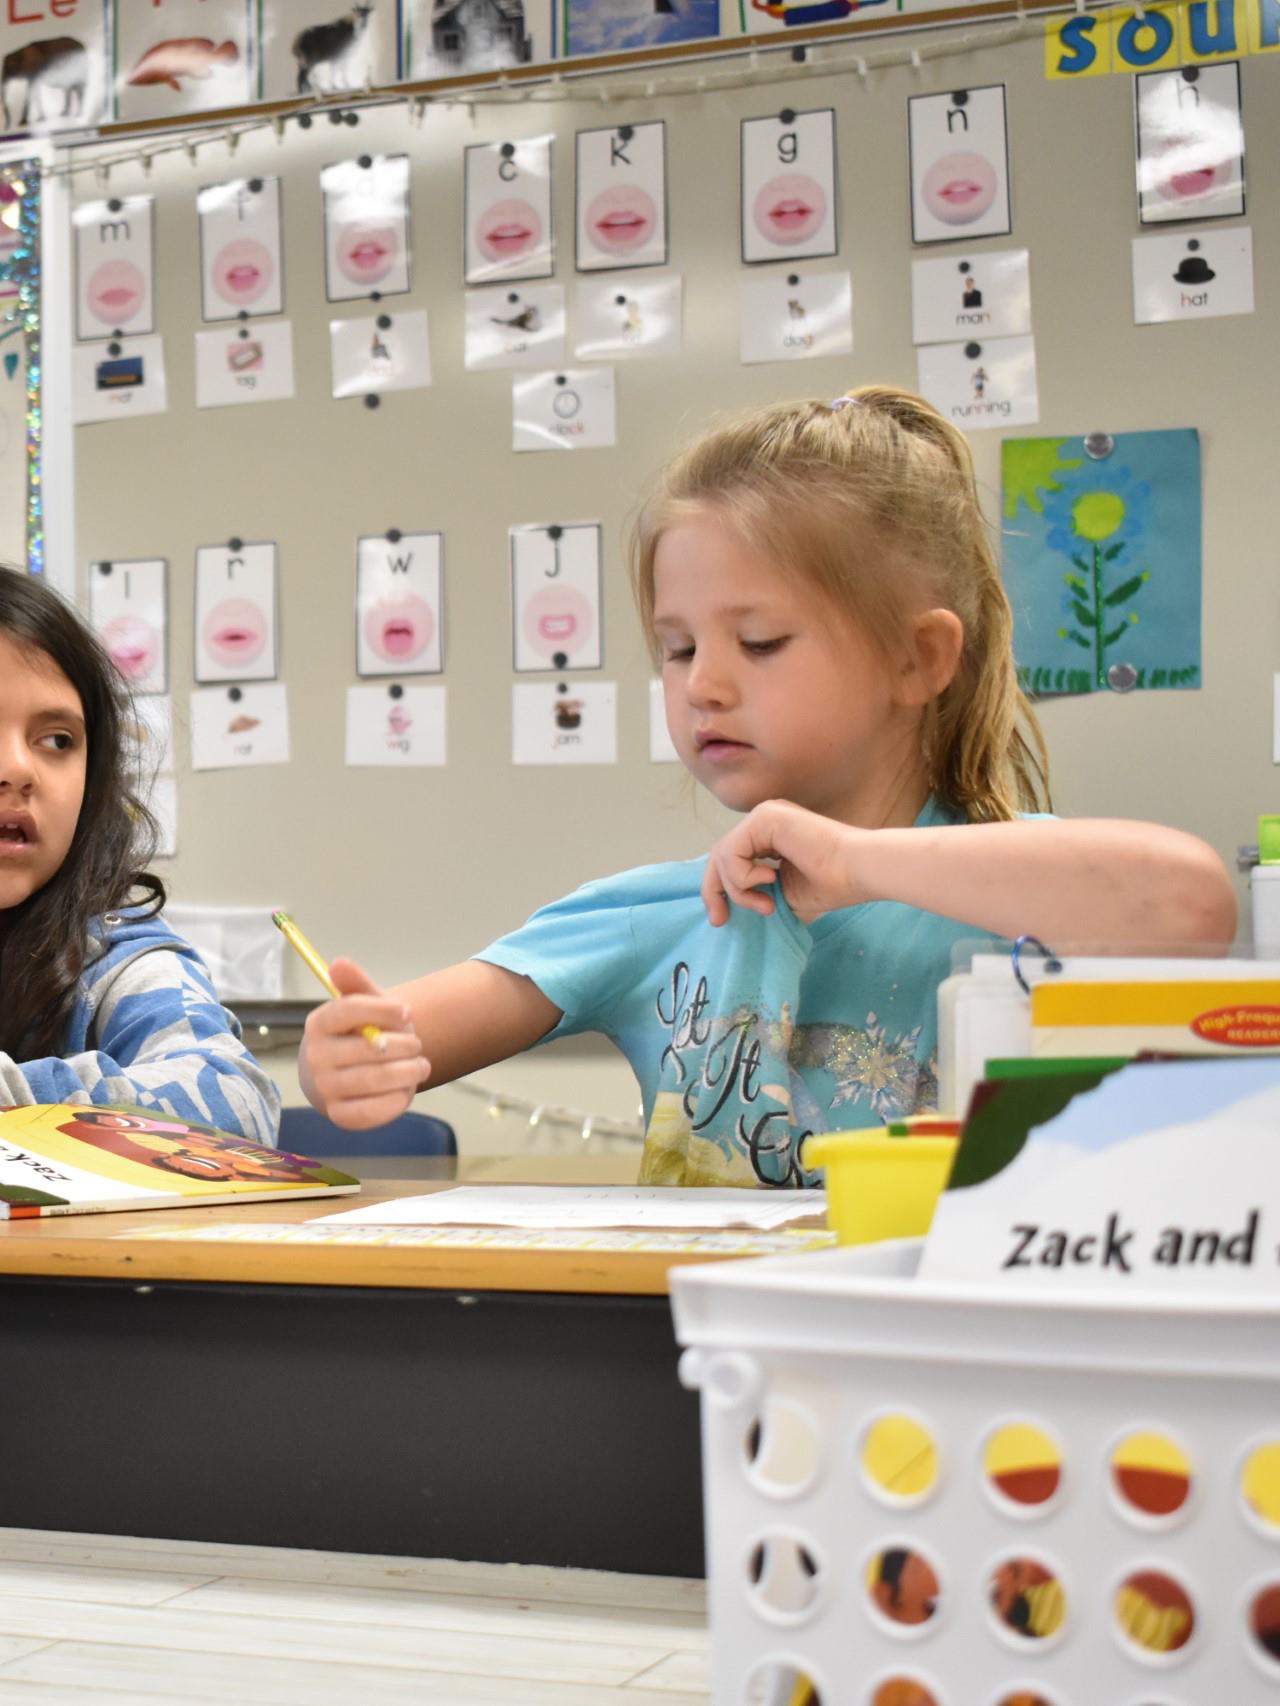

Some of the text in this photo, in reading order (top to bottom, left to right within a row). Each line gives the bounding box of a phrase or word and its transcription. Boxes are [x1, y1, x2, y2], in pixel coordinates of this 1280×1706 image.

[1056, 0, 1280, 74] sou
[947, 108, 969, 133] n
[777, 132, 798, 164] g
[498, 159, 518, 182] c
[99, 221, 131, 243] m
[1180, 291, 1208, 307] hat
[955, 312, 993, 326] man
[951, 400, 1012, 418] running
[226, 557, 245, 580] r
[386, 551, 414, 575] w
[5, 1152, 74, 1182] Zack
[1001, 1206, 1261, 1275] Zack and
